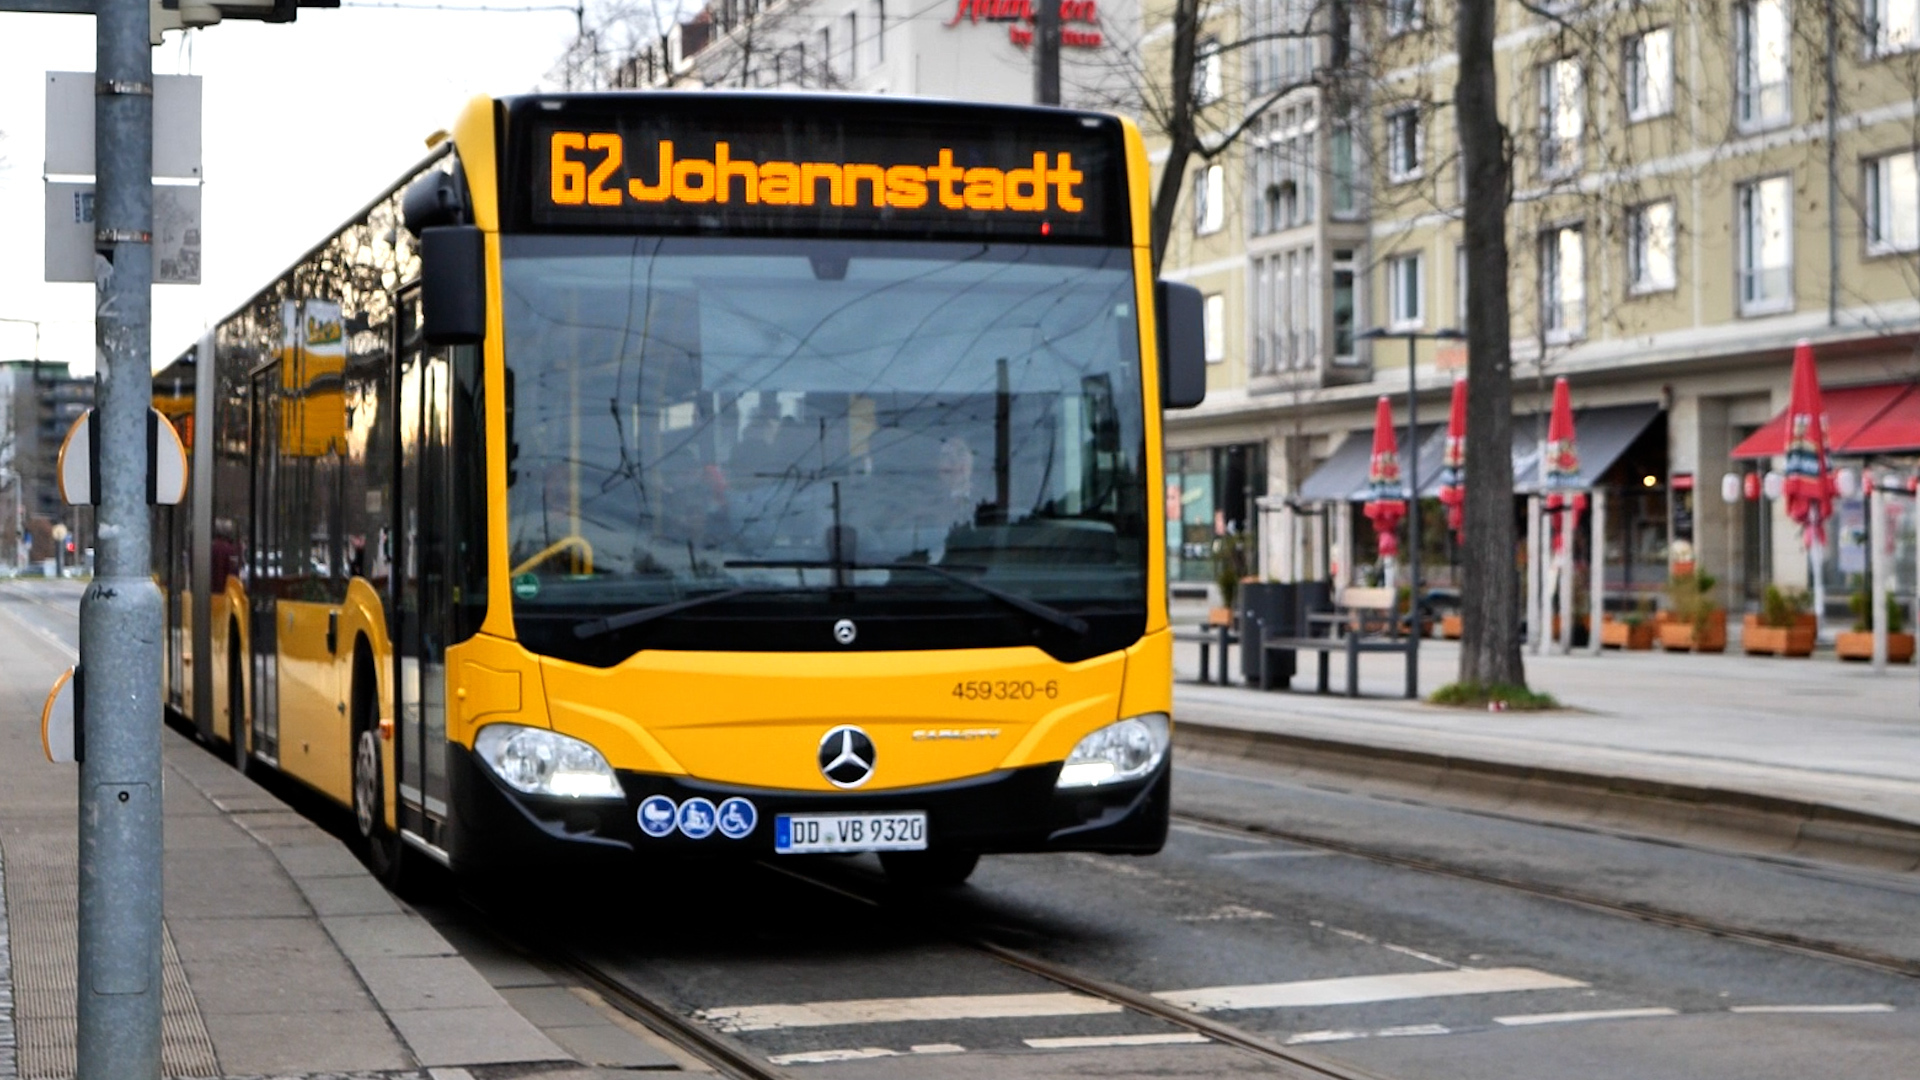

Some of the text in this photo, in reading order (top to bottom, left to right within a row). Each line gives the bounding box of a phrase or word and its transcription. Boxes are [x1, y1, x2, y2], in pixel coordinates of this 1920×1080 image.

[551, 131, 1083, 212] 62 Johannstadt
[952, 680, 1058, 700] 459320-6
[793, 818, 922, 844] DD VB 9320
